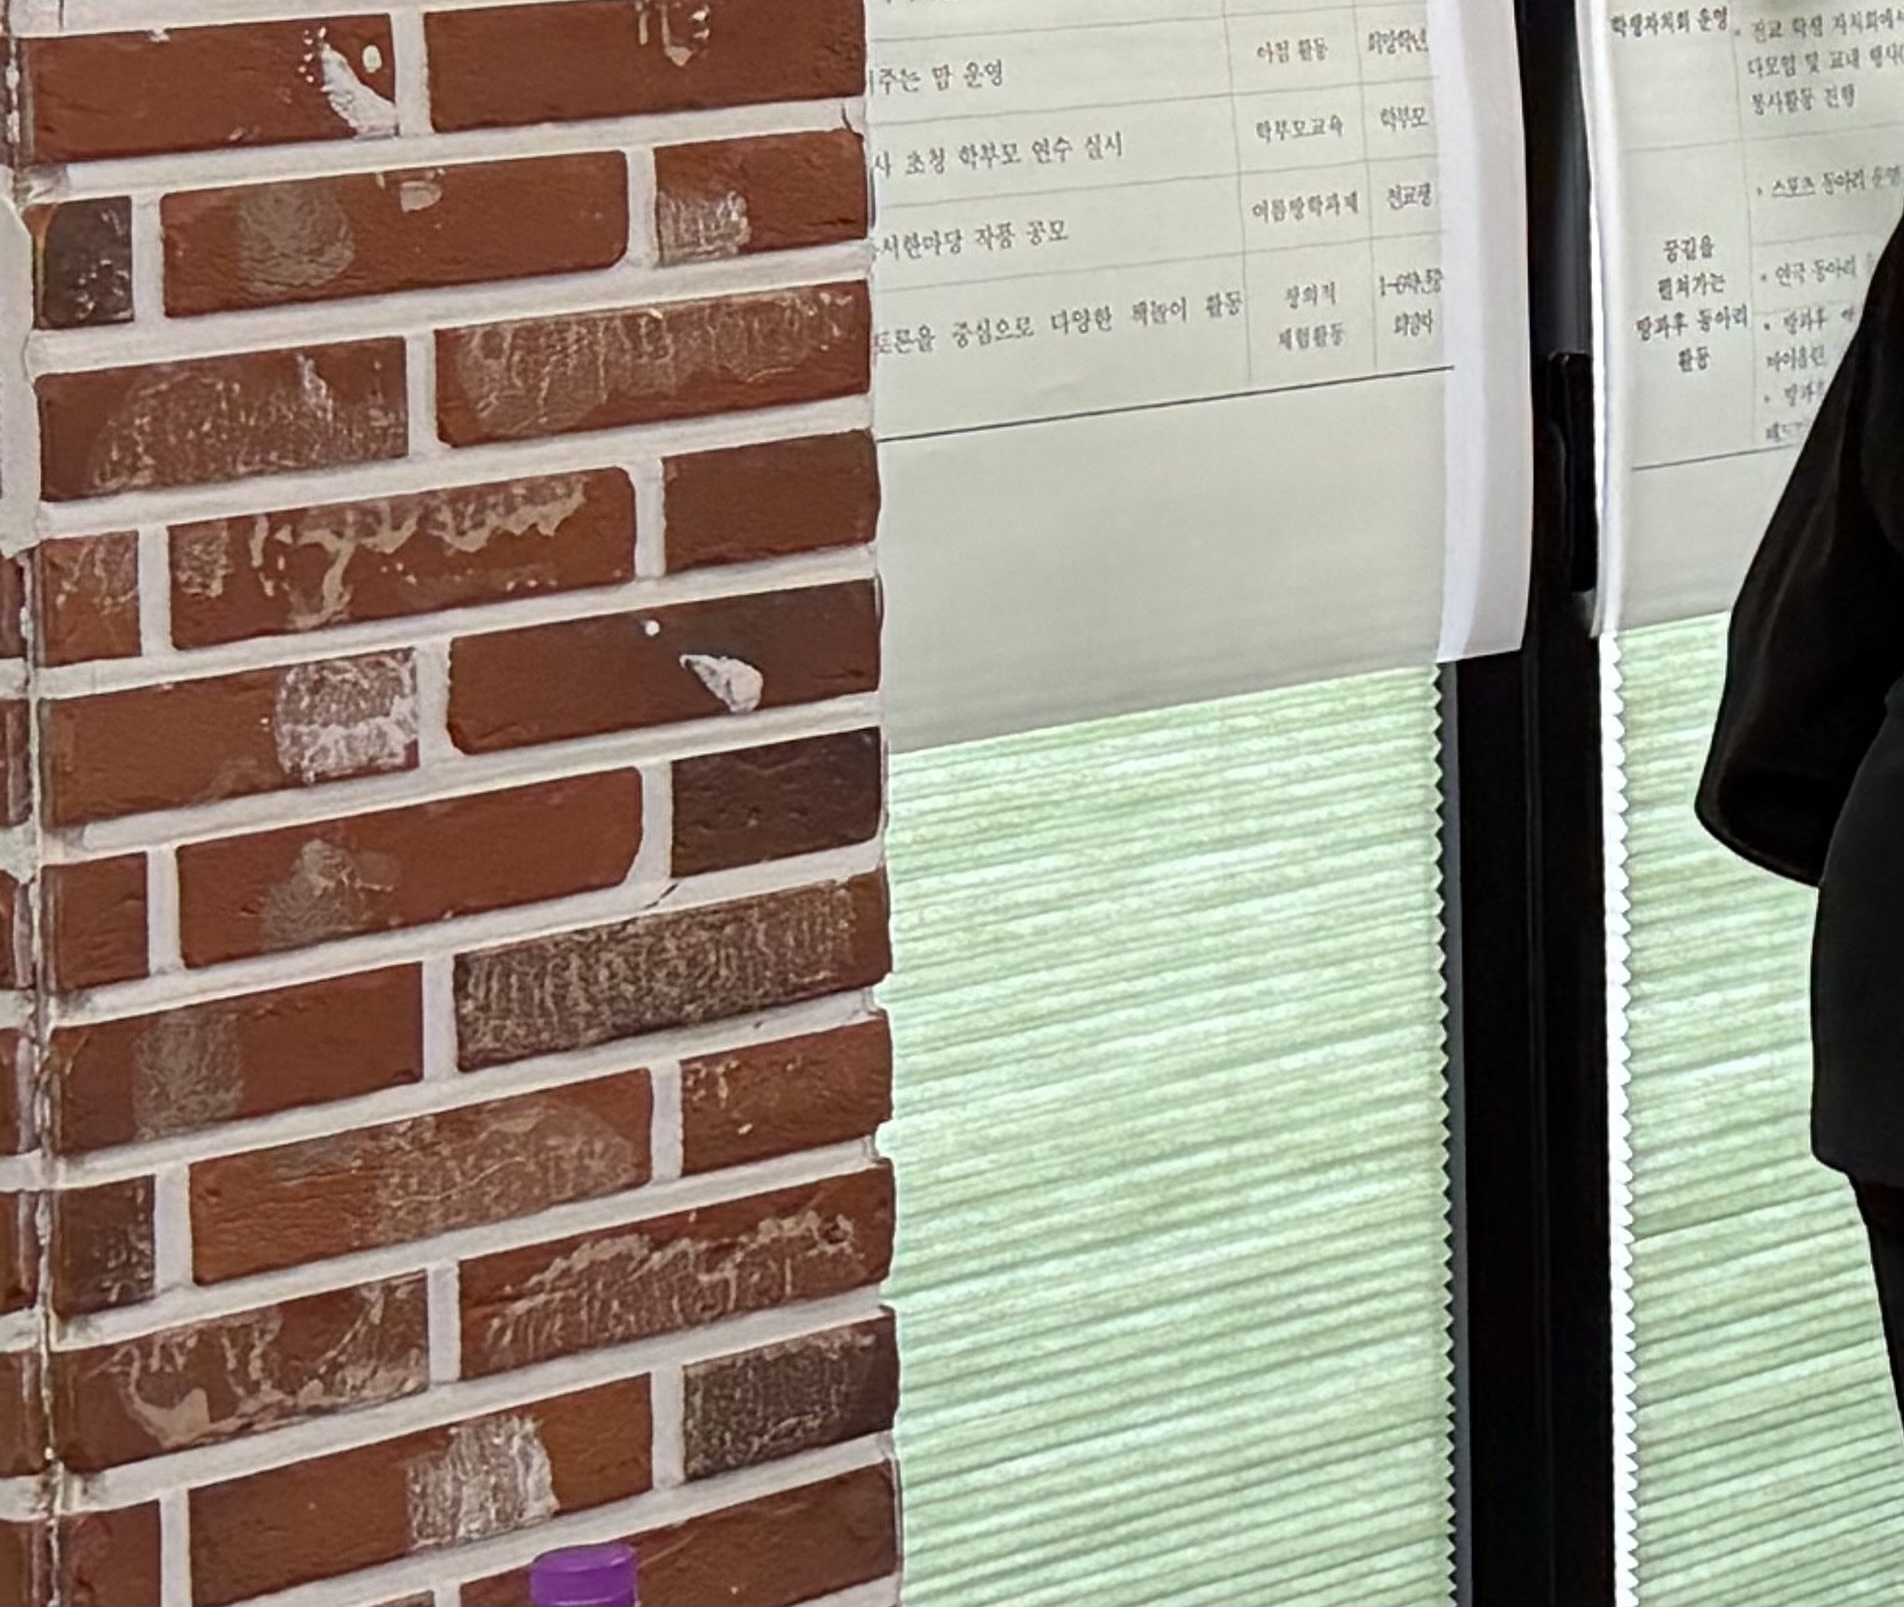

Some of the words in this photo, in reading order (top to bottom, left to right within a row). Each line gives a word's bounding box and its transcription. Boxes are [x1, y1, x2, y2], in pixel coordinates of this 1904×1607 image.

[870, 68, 921, 95] 주는
[963, 59, 1002, 88] 운영
[958, 142, 1021, 170] 학부모
[1085, 131, 1121, 160] 실시
[1822, 169, 1865, 195] 동아리
[1026, 220, 1068, 246] 공모
[1812, 255, 1856, 283] 동아리
[952, 316, 1034, 348] 중심으로
[1051, 306, 1112, 335] 다양한
[1697, 303, 1747, 333] 동아리
[1679, 346, 1710, 372] 활동
